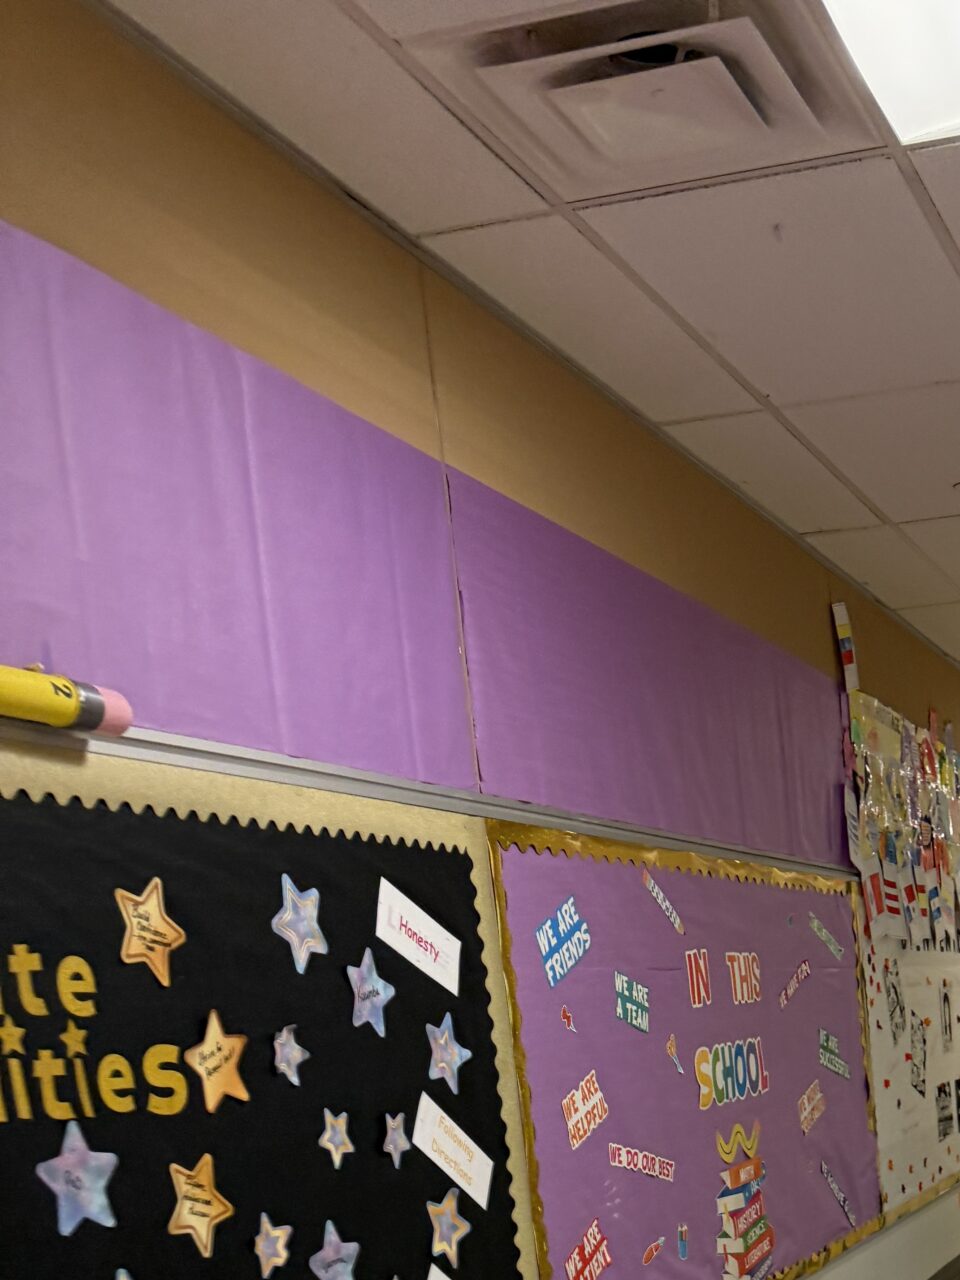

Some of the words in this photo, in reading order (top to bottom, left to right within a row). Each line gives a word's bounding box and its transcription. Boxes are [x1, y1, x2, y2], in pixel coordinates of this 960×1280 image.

[50, 680, 73, 699] 2
[400, 915, 439, 962] Honesty
[536, 919, 557, 956] WE
[556, 896, 580, 937] ARE
[545, 922, 591, 987] FRIENDS
[686, 950, 711, 1006] IN
[726, 953, 761, 1004] THIS
[0, 943, 98, 1017] te
[614, 971, 629, 996] WE
[632, 981, 649, 1007] ARE
[616, 998, 623, 1019] A
[626, 1002, 649, 1032] TEAM
[0, 1015, 189, 1122] ities
[695, 1037, 769, 1109] SCHOOL
[562, 1092, 579, 1121] WE
[580, 1072, 599, 1106] ARE
[438, 1115, 474, 1162] Following
[569, 1097, 608, 1149] HELPFUL
[432, 1138, 472, 1186] Directions
[609, 1144, 623, 1164] WE
[626, 1149, 639, 1169] DO
[642, 1154, 656, 1173] OUR
[658, 1158, 674, 1179] BEST
[738, 1202, 761, 1234] HISTORY
[747, 1220, 766, 1246] SCIENCE
[565, 1247, 583, 1280] WE
[583, 1219, 601, 1258] ARE
